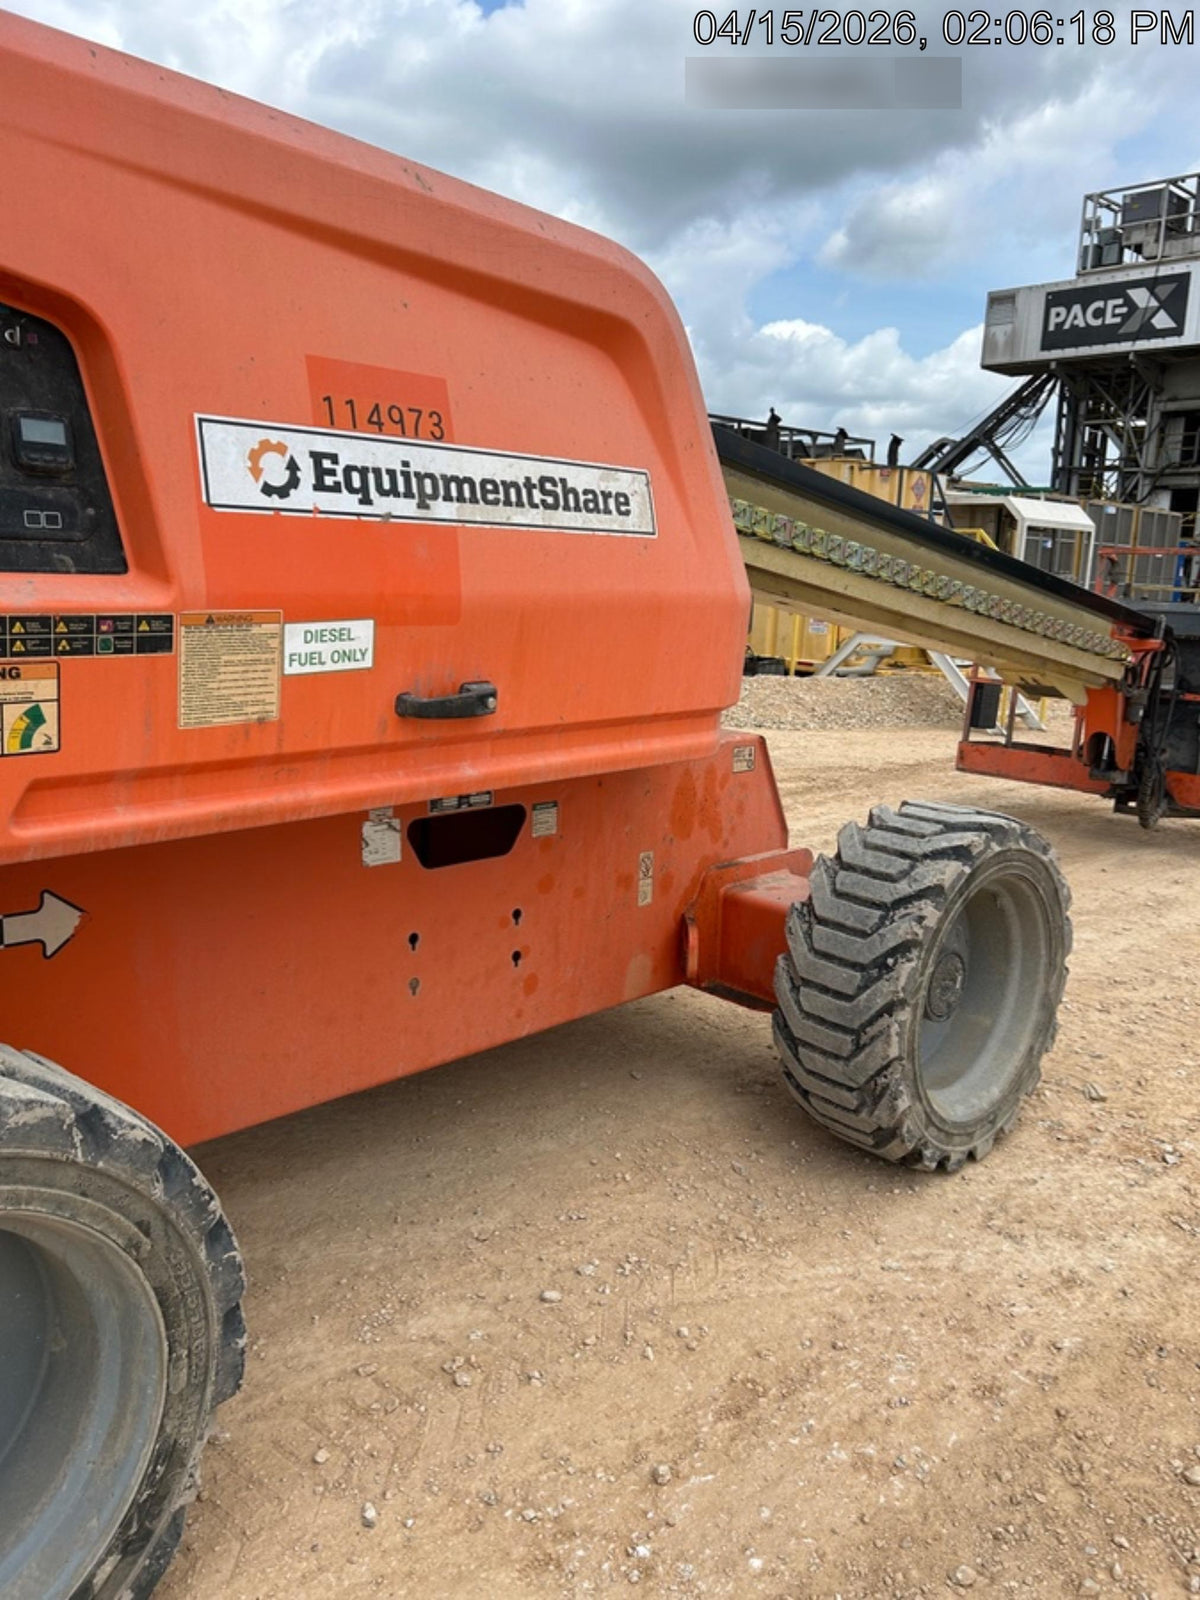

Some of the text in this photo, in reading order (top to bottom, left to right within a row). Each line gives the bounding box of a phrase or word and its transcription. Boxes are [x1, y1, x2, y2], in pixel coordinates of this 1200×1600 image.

[322, 395, 445, 440] 114973
[308, 449, 631, 517] EquipmentShare
[303, 627, 355, 644] DIESEL
[288, 648, 368, 667] FUEL ONLY
